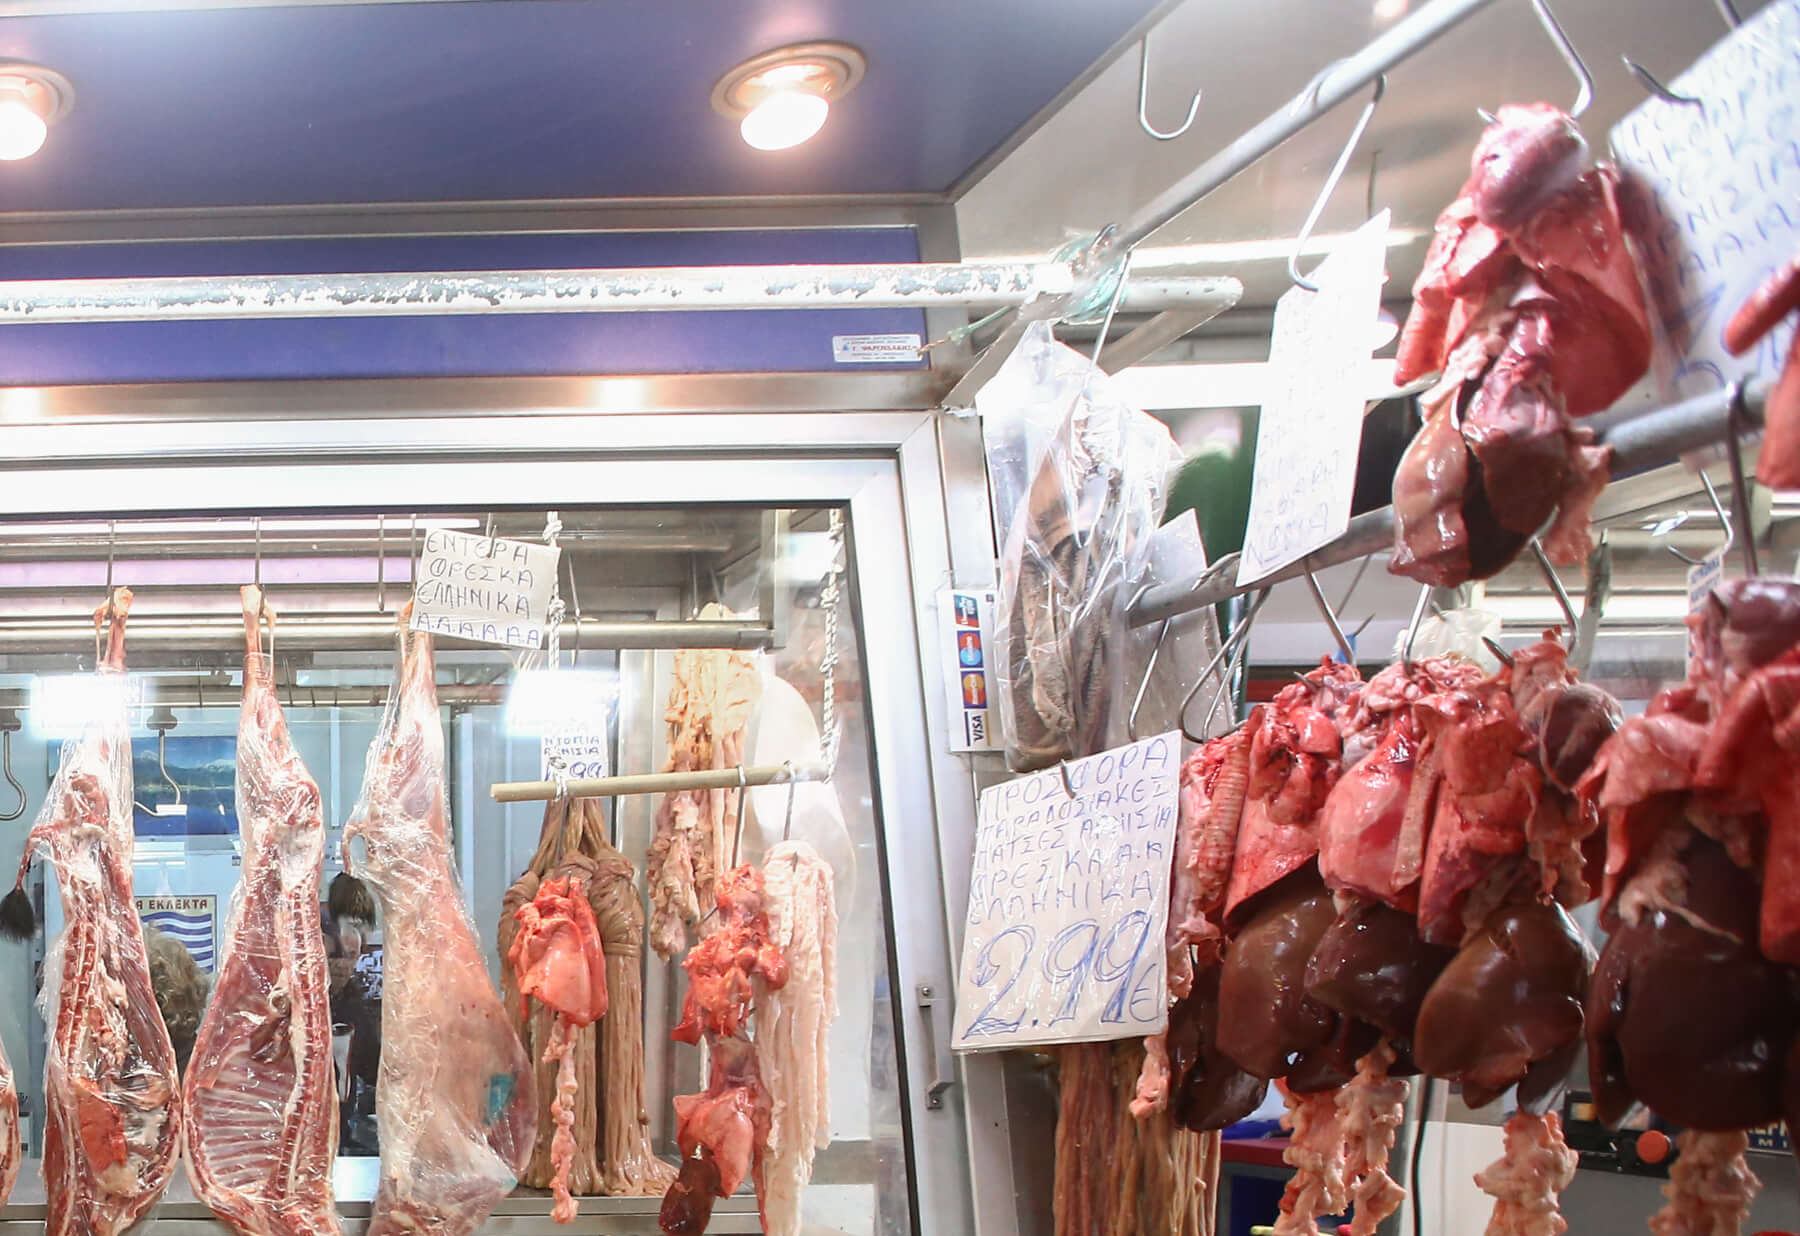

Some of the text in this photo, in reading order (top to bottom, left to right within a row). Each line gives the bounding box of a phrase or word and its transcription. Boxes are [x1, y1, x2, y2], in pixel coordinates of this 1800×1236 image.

[426, 532, 529, 566] ΕΝΤΕΡΑ
[429, 557, 534, 589] ΦΡΕΣΚΑ
[972, 715, 984, 742] VISA
[983, 738, 1169, 821] ΠΡΟΣΦΟΡΑ
[148, 898, 208, 911] ΕΚΛΕΚΤΑ
